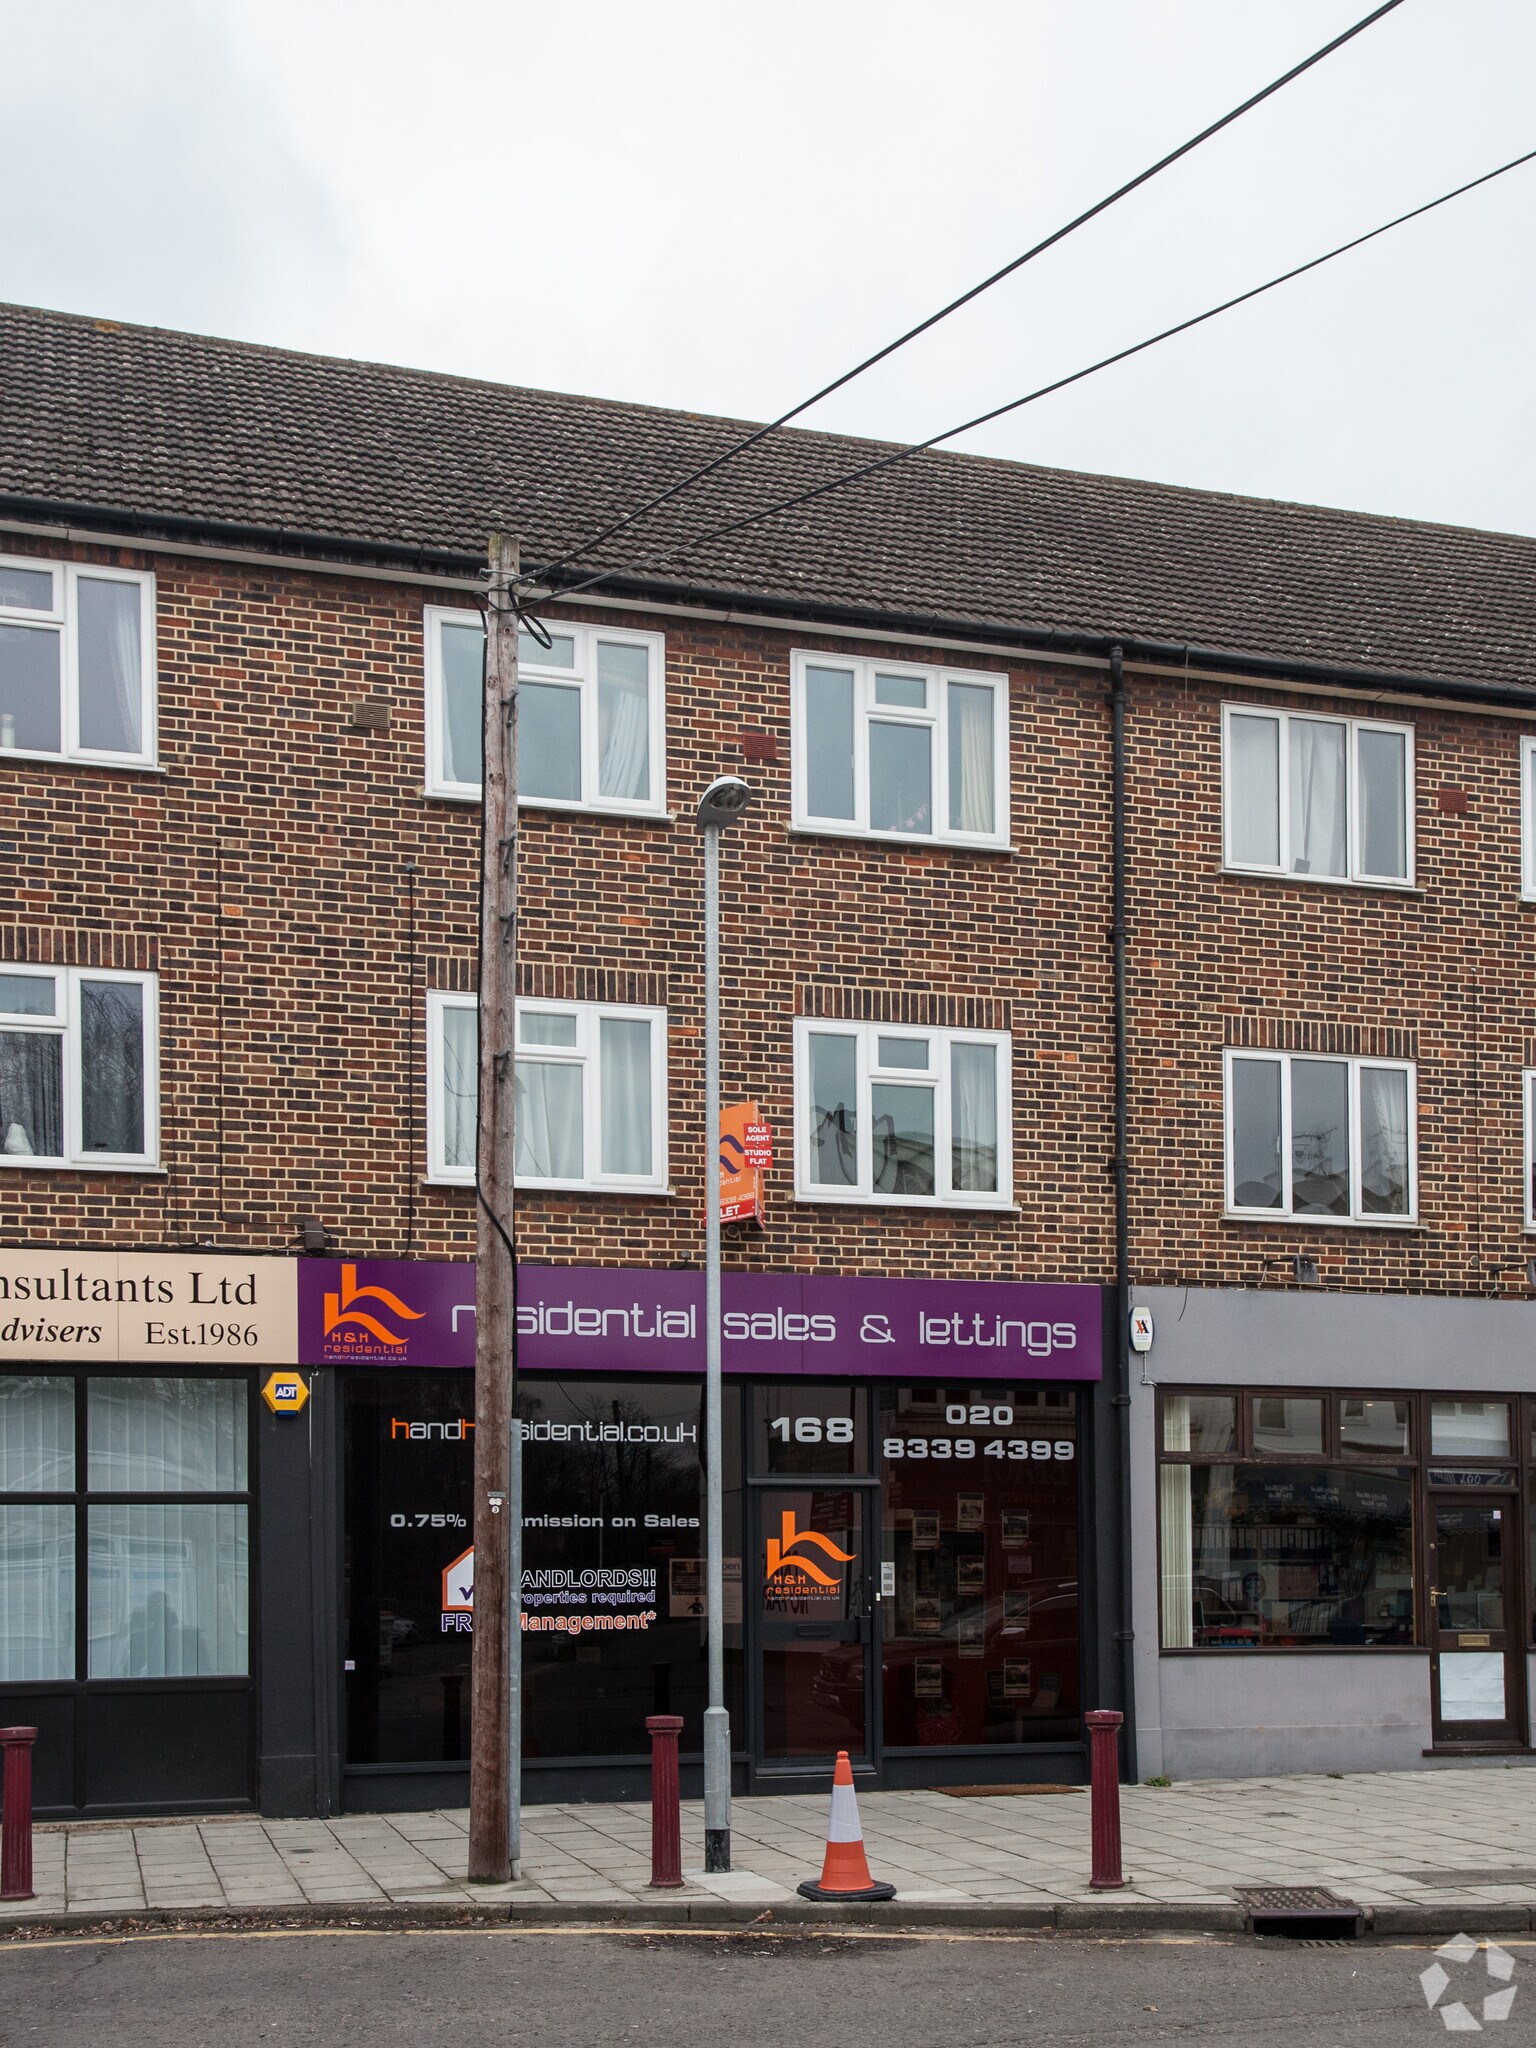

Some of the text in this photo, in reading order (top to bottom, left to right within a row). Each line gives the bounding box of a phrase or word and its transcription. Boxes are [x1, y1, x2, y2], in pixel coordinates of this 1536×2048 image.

[720, 1204, 740, 1218] LET
[188, 1271, 258, 1305] Ltd
[144, 1321, 259, 1347] Est.1986
[451, 1300, 1077, 1357] rsidential sales & lettings
[332, 1332, 368, 1343] H&H
[324, 1345, 407, 1354] residential
[275, 1386, 297, 1399] ADT
[945, 1405, 1014, 1426] 020
[391, 1417, 697, 1443] handhsidential.co.uk
[770, 1416, 855, 1443] 168
[882, 1438, 1075, 1461] 8339 4399
[390, 1513, 700, 1528] 0.75% mission on Sales
[773, 1575, 806, 1585] H&H
[591, 1590, 656, 1606] required
[767, 1586, 840, 1594] residential
